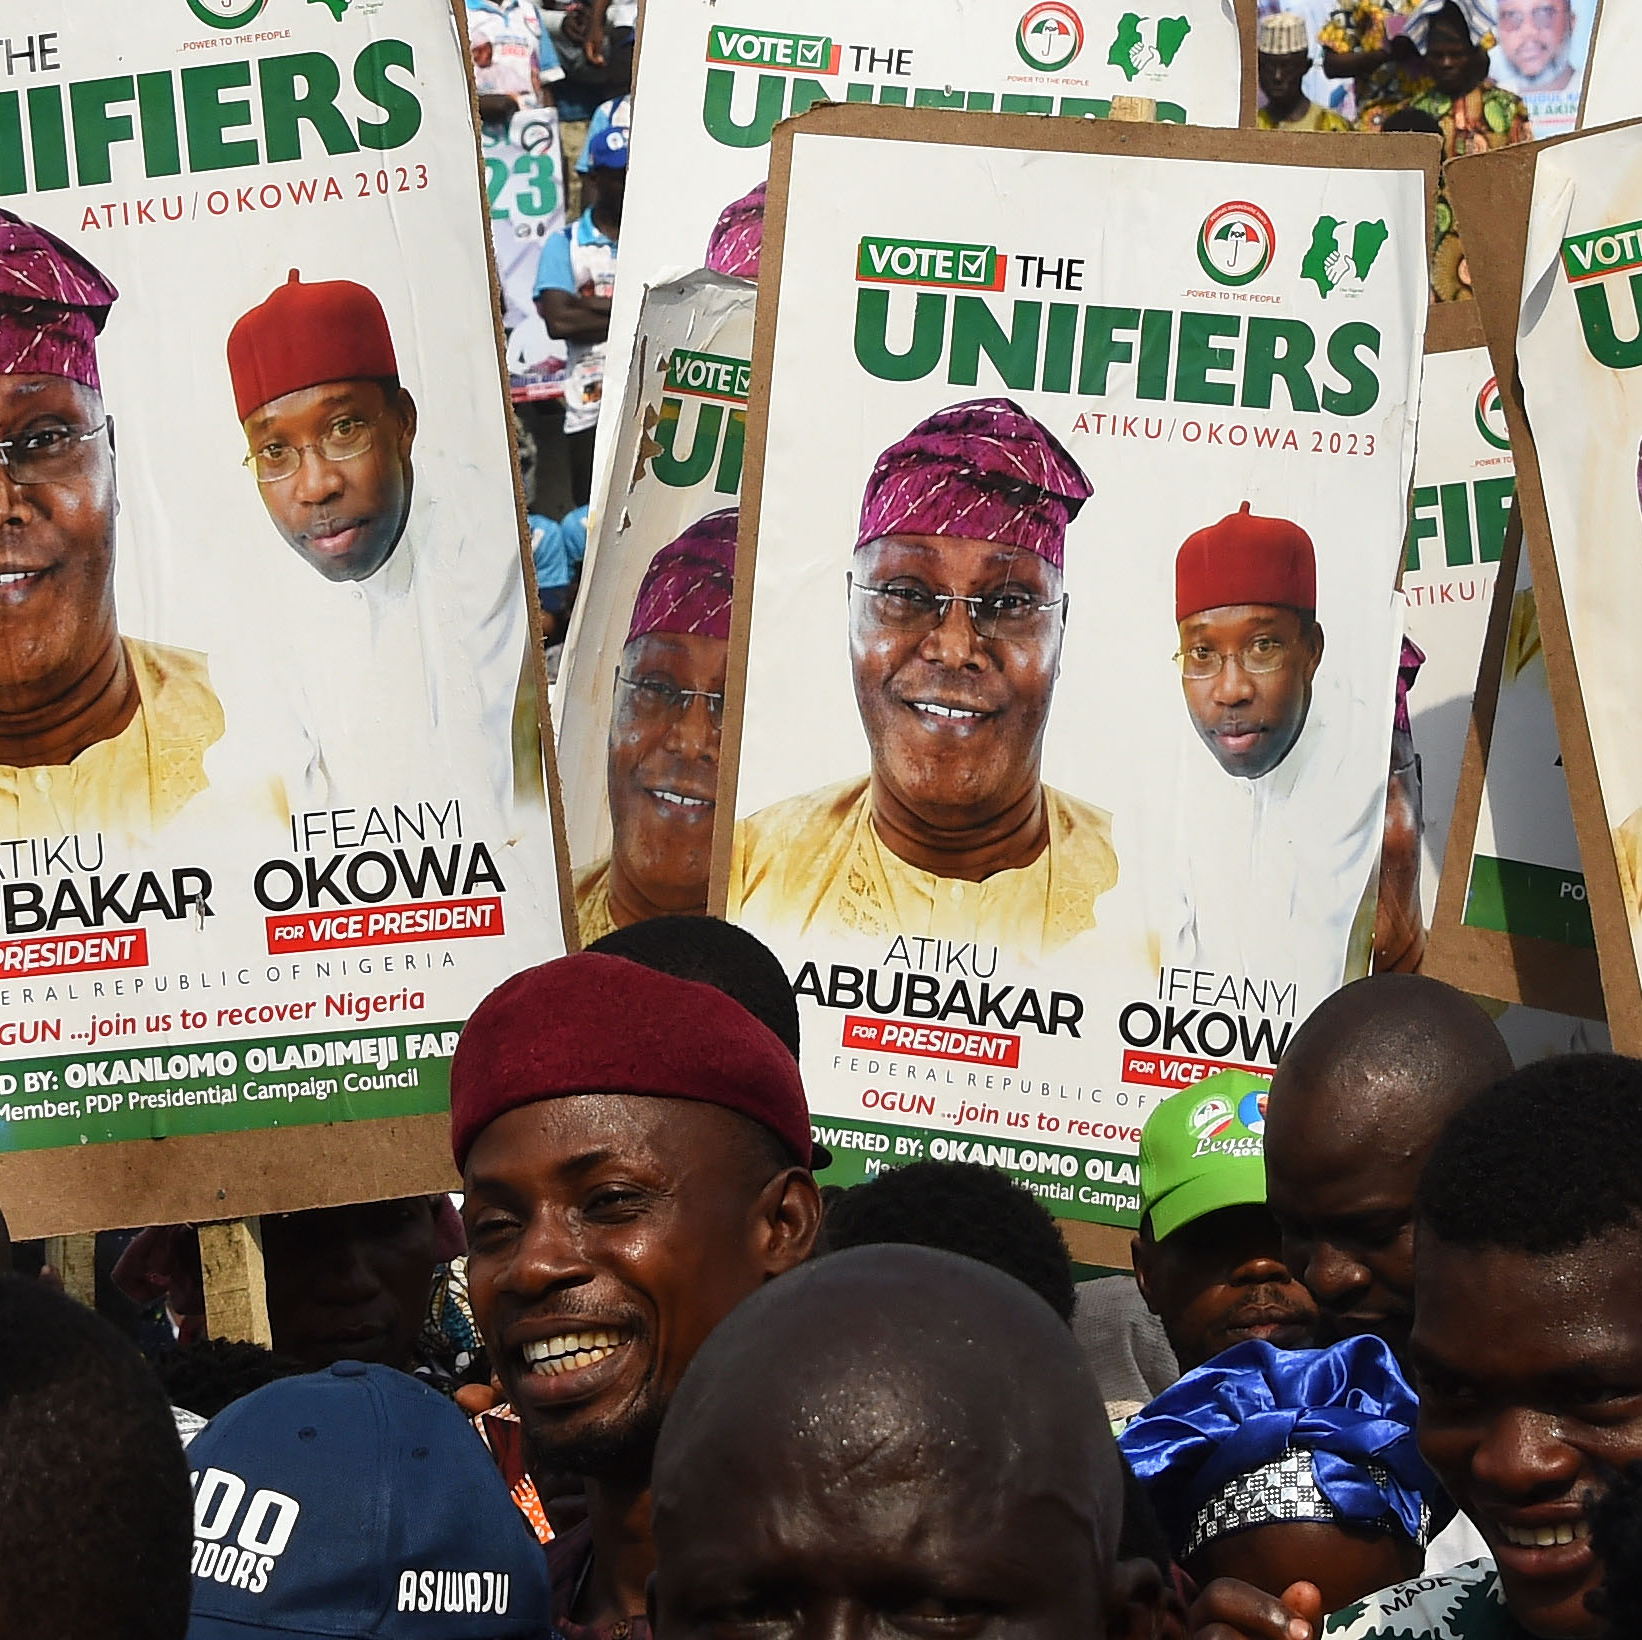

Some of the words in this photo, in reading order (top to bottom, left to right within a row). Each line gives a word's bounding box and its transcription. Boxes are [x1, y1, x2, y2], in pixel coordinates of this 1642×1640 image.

[716, 31, 795, 66] VOTE
[850, 46, 913, 75] THE
[82, 177, 342, 231] ATIKU/OKOWA
[356, 165, 427, 197] 2023
[869, 245, 953, 278] VOTE
[1016, 256, 1084, 291] THE
[854, 288, 1380, 416] UNIFIERS
[1072, 414, 1298, 450] ATIKU/OKOWA
[1312, 431, 1374, 456] 2023
[291, 800, 462, 852] IFEANYI
[254, 836, 506, 911] OKOWA
[275, 926, 304, 940] FOR
[309, 916, 363, 941] VICE
[368, 905, 495, 936] PRESIDENT
[71, 1013, 136, 1045] ...join
[146, 1015, 171, 1032] us
[181, 1010, 207, 1029] to
[218, 1002, 316, 1026] recover
[326, 988, 424, 1021] Nigeria
[786, 956, 1083, 1043] ABUBAKAR
[1119, 1002, 1297, 1068] OKOW
[24, 1071, 58, 1092] BY:
[63, 1050, 238, 1091] OKANLOMO
[244, 1035, 399, 1075] OLADIMEJI
[396, 1568, 511, 1616] ASIWAJU
